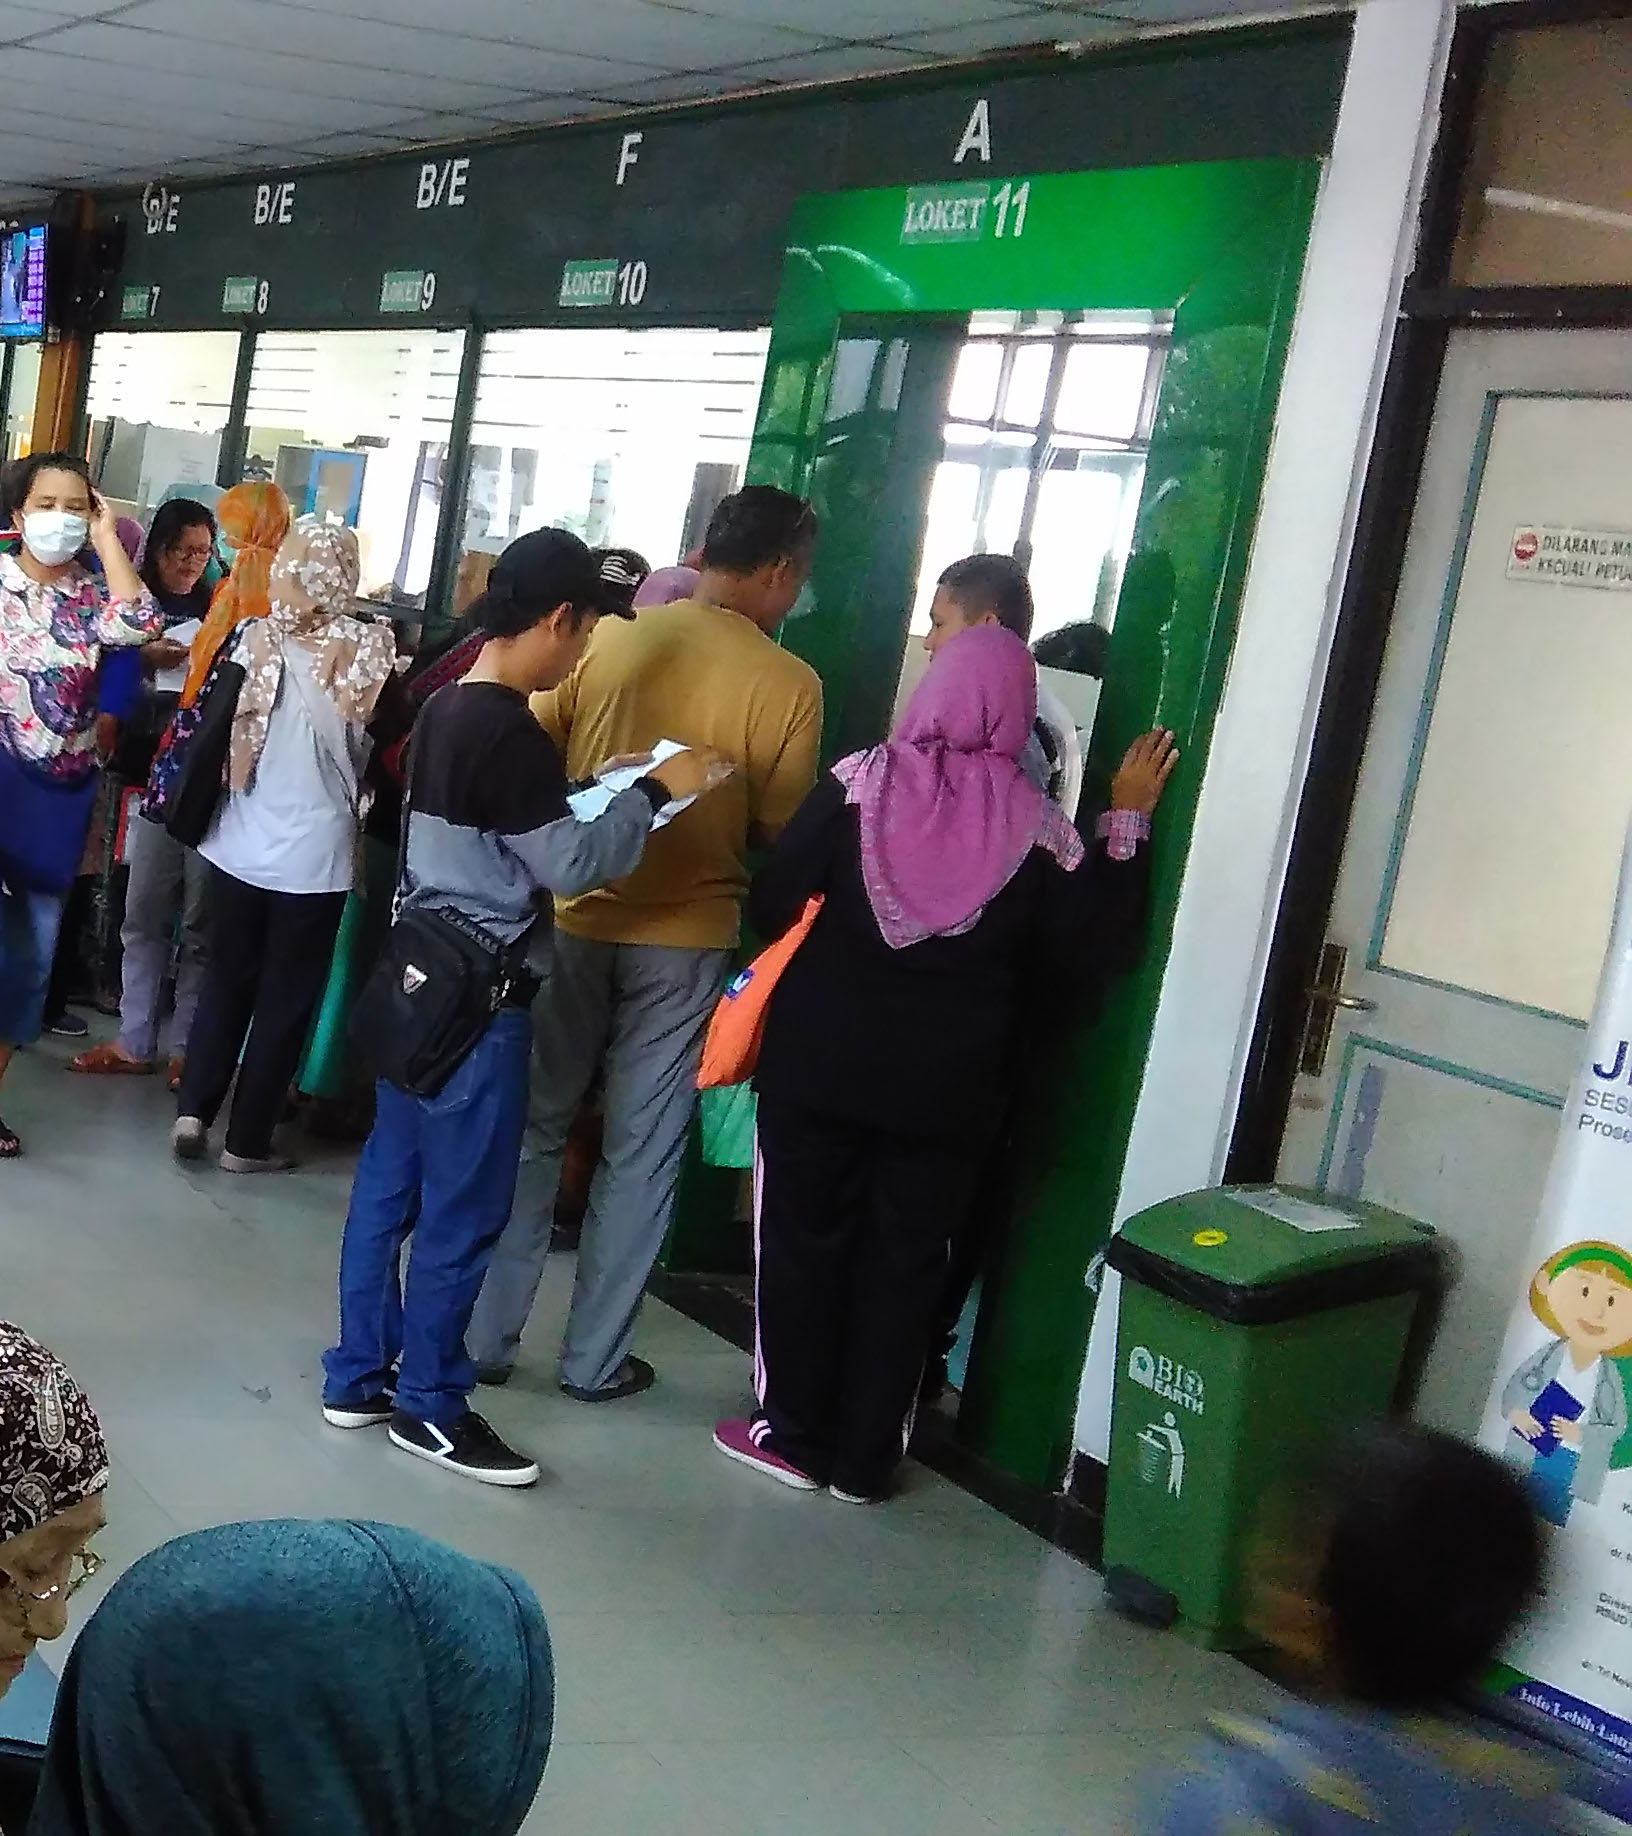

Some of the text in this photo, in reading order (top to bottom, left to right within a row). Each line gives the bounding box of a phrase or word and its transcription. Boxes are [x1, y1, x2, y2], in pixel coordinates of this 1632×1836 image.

[953, 99, 991, 163] A
[617, 131, 644, 185] F
[254, 182, 296, 225] B/E
[416, 158, 470, 209] B/E
[905, 181, 1030, 238] LOKET 11
[148, 285, 161, 318] 7
[257, 280, 269, 315] 8
[421, 272, 436, 311] 9
[561, 260, 648, 306] LOKET 10
[1593, 1040, 1632, 1086] J
[1584, 1089, 1632, 1118] SES
[1154, 1378, 1204, 1416] EARTH
